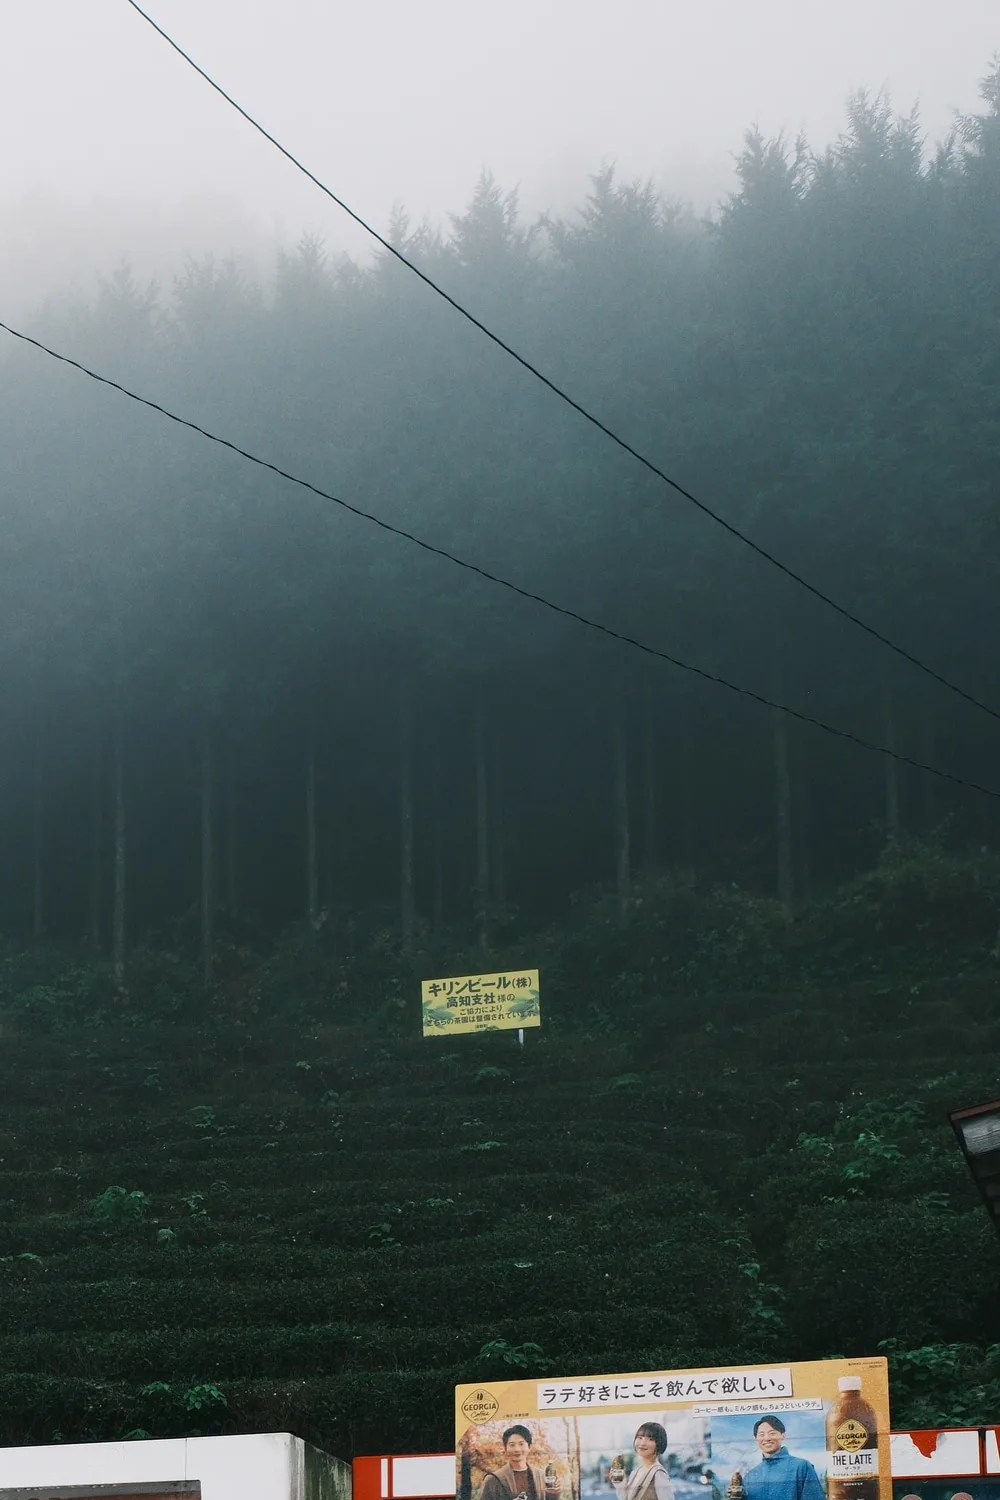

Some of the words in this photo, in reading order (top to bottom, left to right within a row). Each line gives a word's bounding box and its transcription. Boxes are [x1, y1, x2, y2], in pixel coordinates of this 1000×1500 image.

[428, 976, 532, 997] キリンビール(株)
[543, 1377, 786, 1404] ラテ好きにこそ飲んで欲しい。
[464, 1403, 497, 1412] GEORGIA
[832, 1455, 847, 1466] THE
[849, 1453, 872, 1466] LATTE
